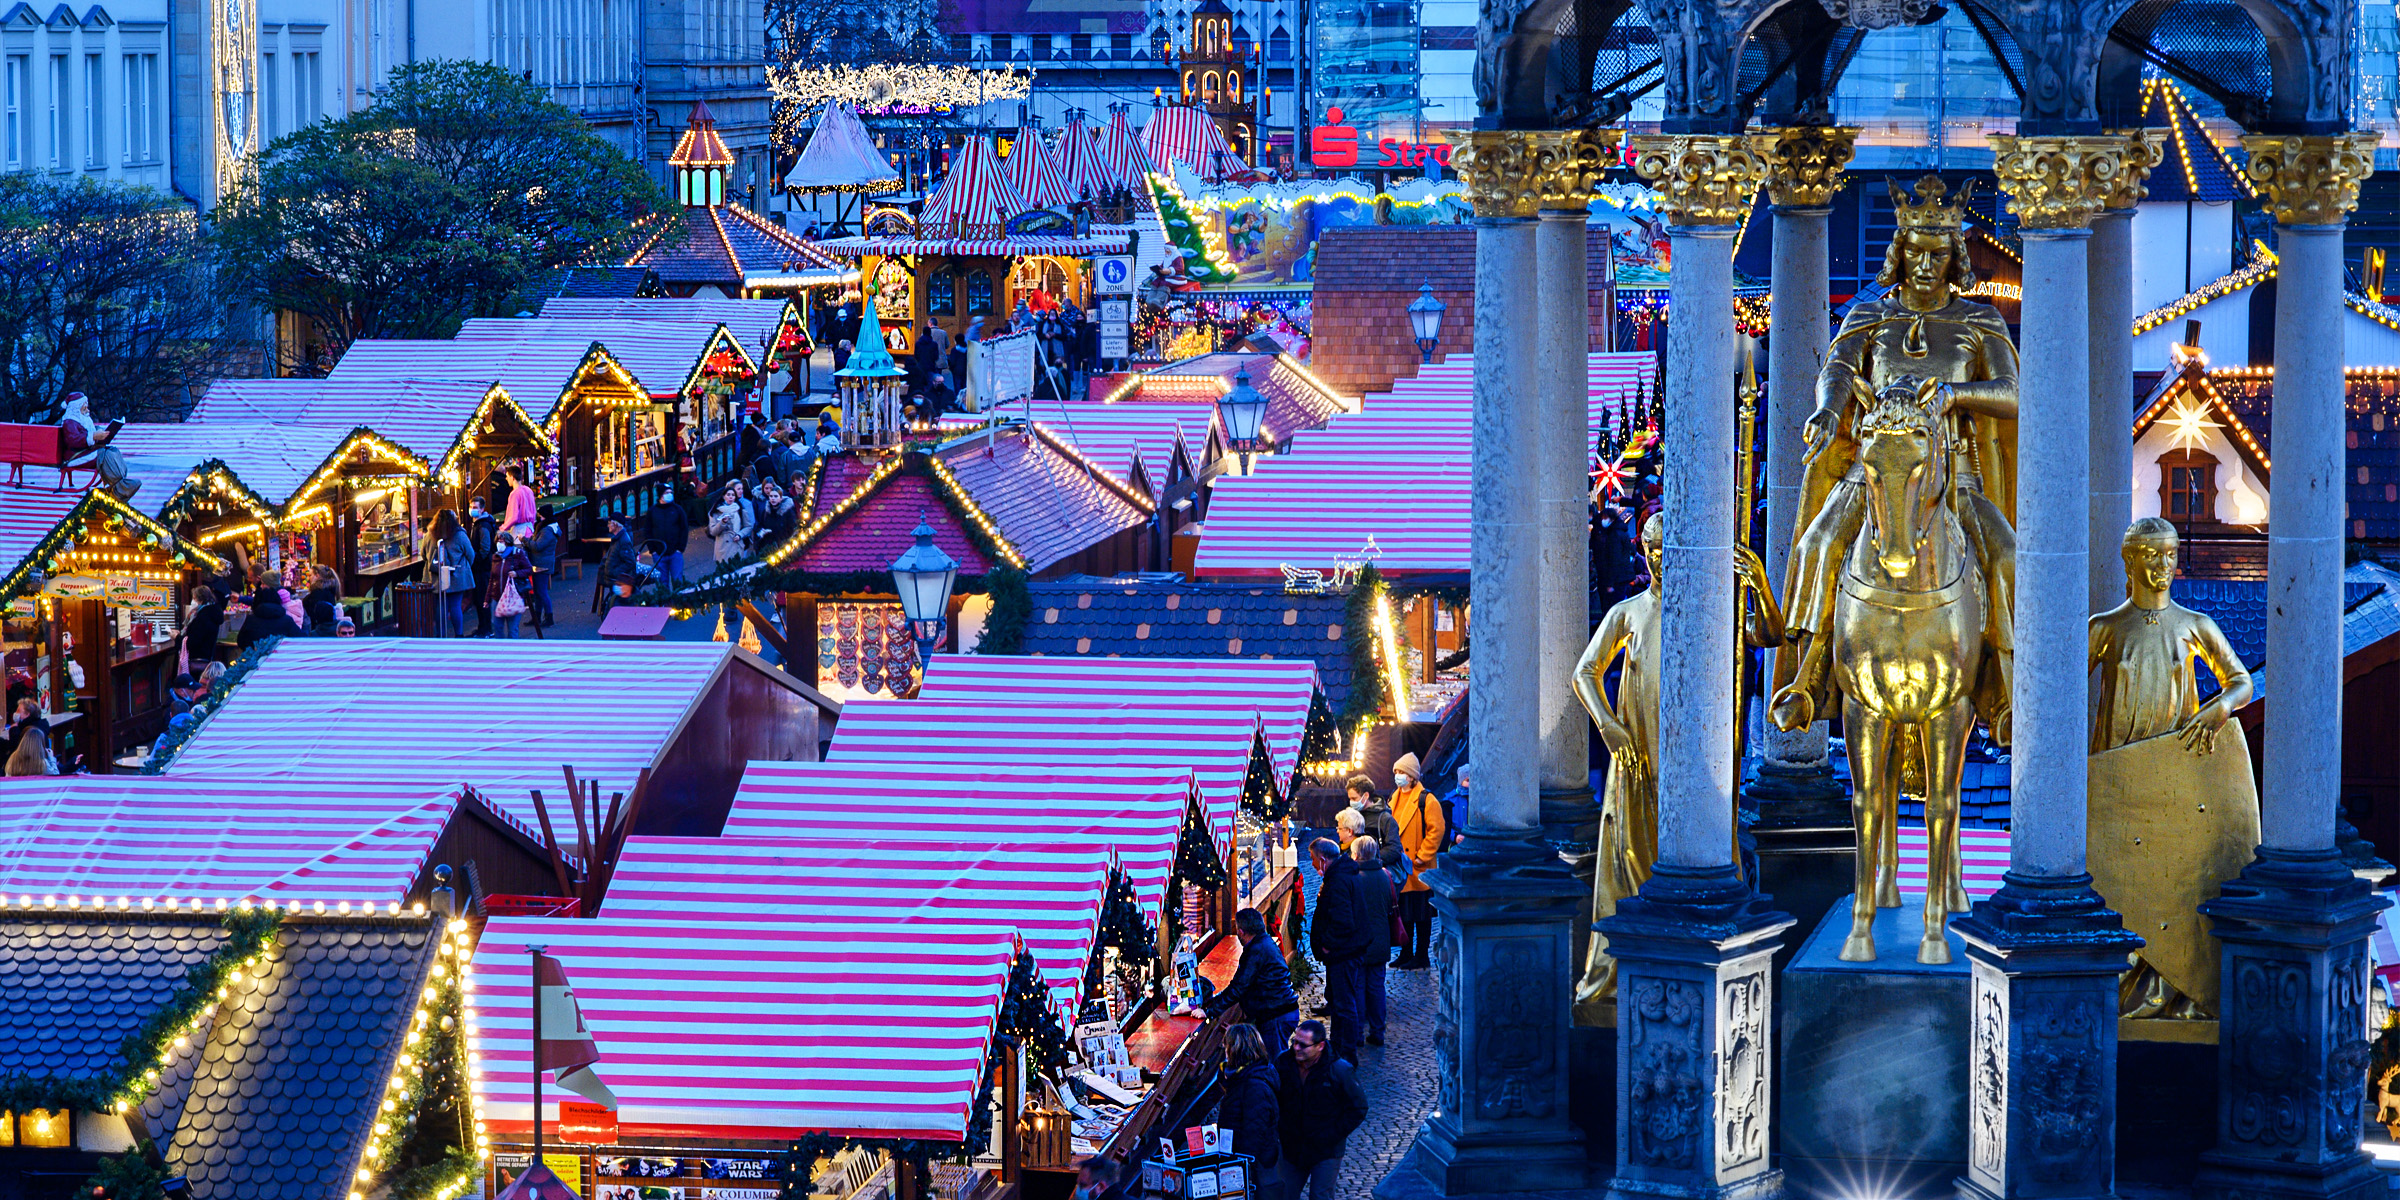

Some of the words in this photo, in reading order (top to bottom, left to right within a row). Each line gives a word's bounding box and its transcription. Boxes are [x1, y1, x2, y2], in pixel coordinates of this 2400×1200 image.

[1378, 138, 1453, 167] Stad
[109, 579, 131, 588] Heidi
[728, 1161, 763, 1169] STAR
[598, 1166, 622, 1176] BATMAN
[653, 1166, 675, 1177] JOKER
[729, 1170, 763, 1178] WARS
